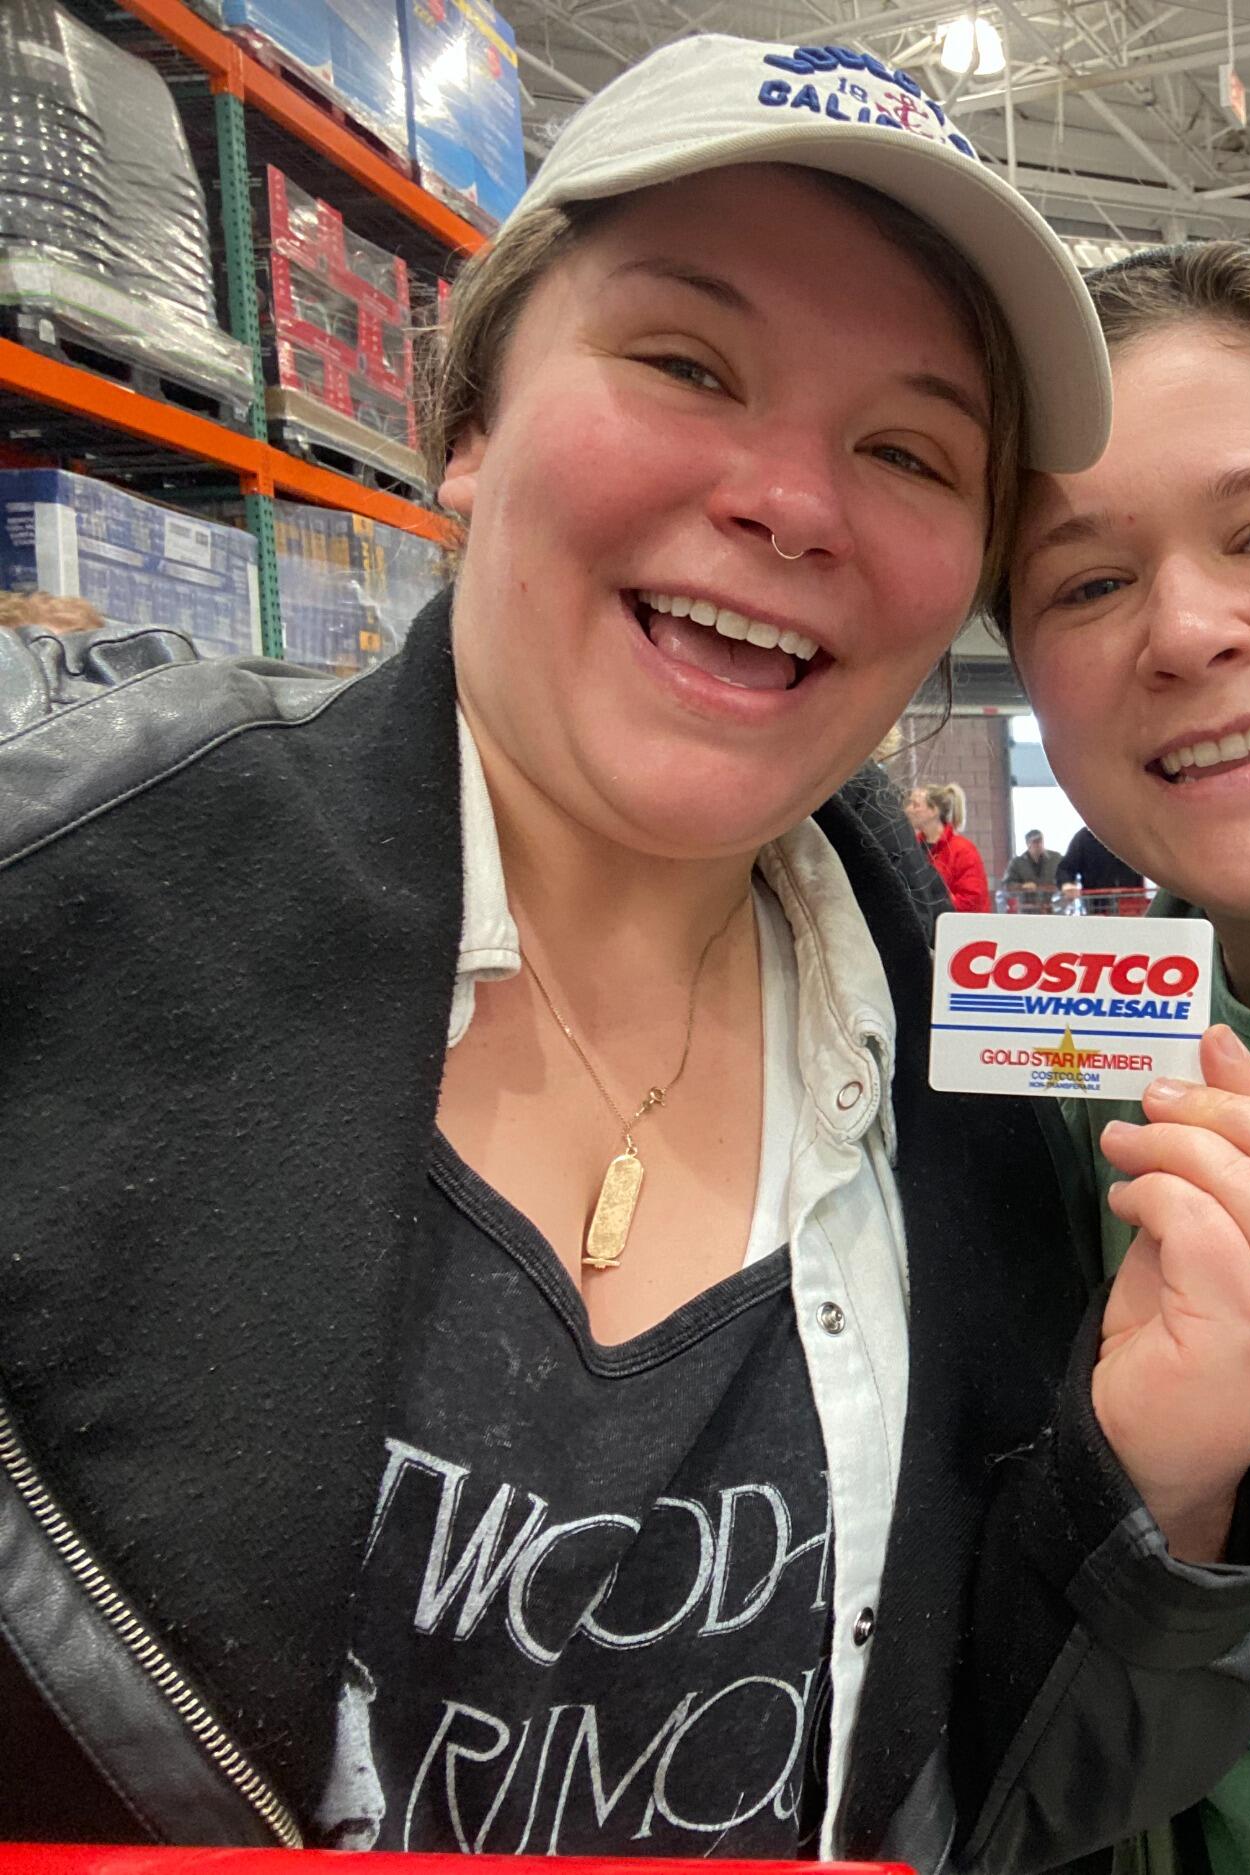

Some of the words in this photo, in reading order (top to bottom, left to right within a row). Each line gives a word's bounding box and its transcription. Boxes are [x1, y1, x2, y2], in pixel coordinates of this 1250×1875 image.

[948, 940, 1199, 997] COSTCO
[1024, 996, 1192, 1020] WHOLESALE
[980, 1049, 1030, 1067] GOLD
[1031, 1051, 1074, 1069] STAR
[1077, 1053, 1153, 1071] MEMBER
[1031, 1070, 1100, 1082] COSTCO.COM
